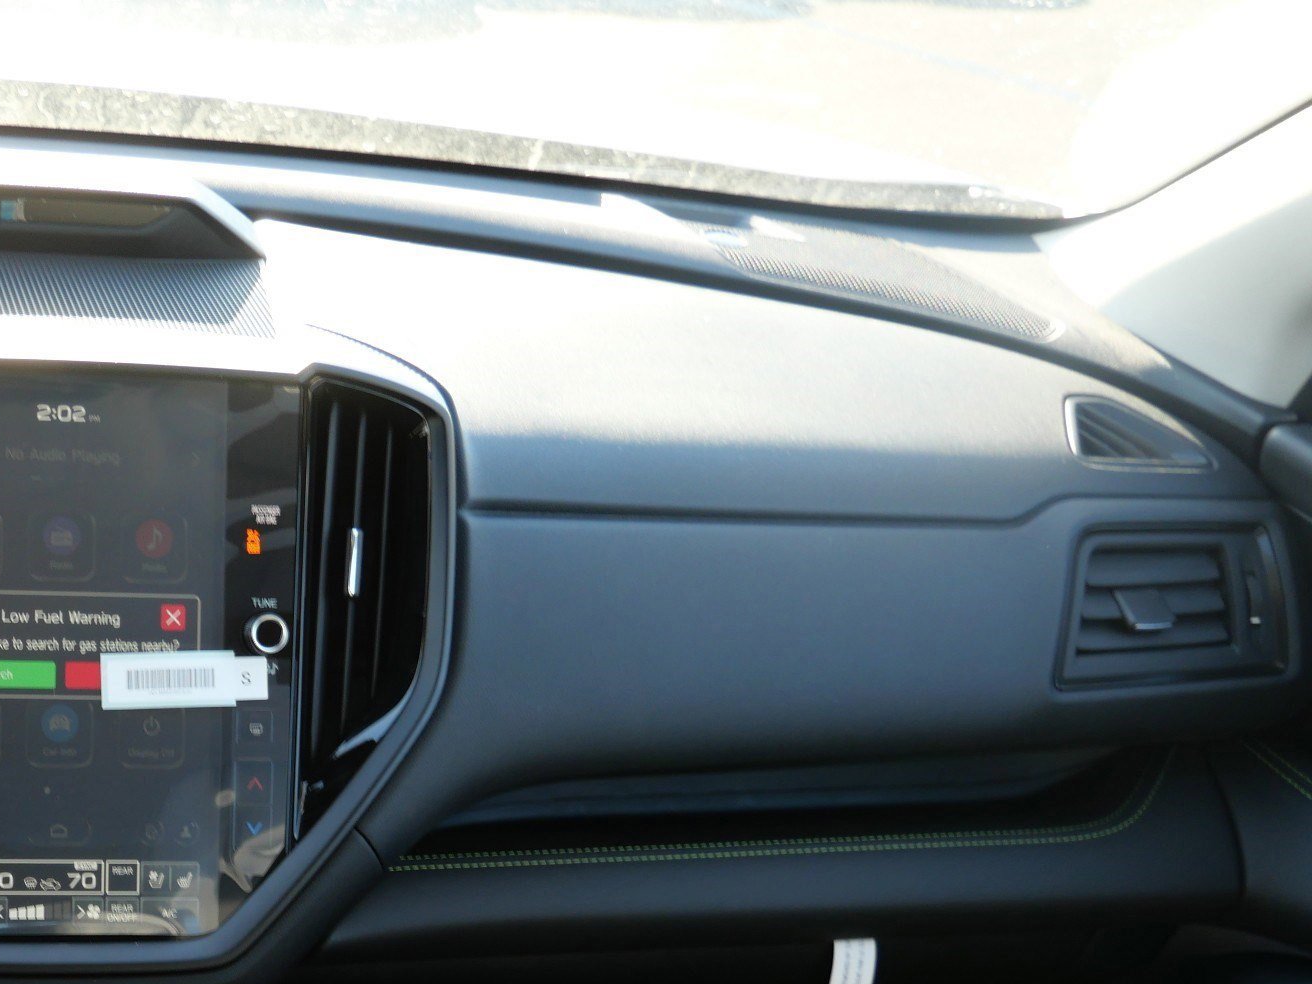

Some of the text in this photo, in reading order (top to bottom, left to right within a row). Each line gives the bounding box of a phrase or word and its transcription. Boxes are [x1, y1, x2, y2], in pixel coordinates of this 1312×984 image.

[36, 403, 86, 423] 2:02
[251, 597, 278, 609] TUNE
[1, 609, 121, 629] Low Fuel Warning
[12, 637, 24, 651] to
[25, 636, 60, 651] search
[62, 637, 77, 651] for
[79, 639, 97, 654] gas
[100, 638, 138, 653] stations
[241, 671, 252, 685] S
[111, 865, 135, 876] REAR
[67, 872, 97, 890] 70
[110, 903, 134, 914] REAR
